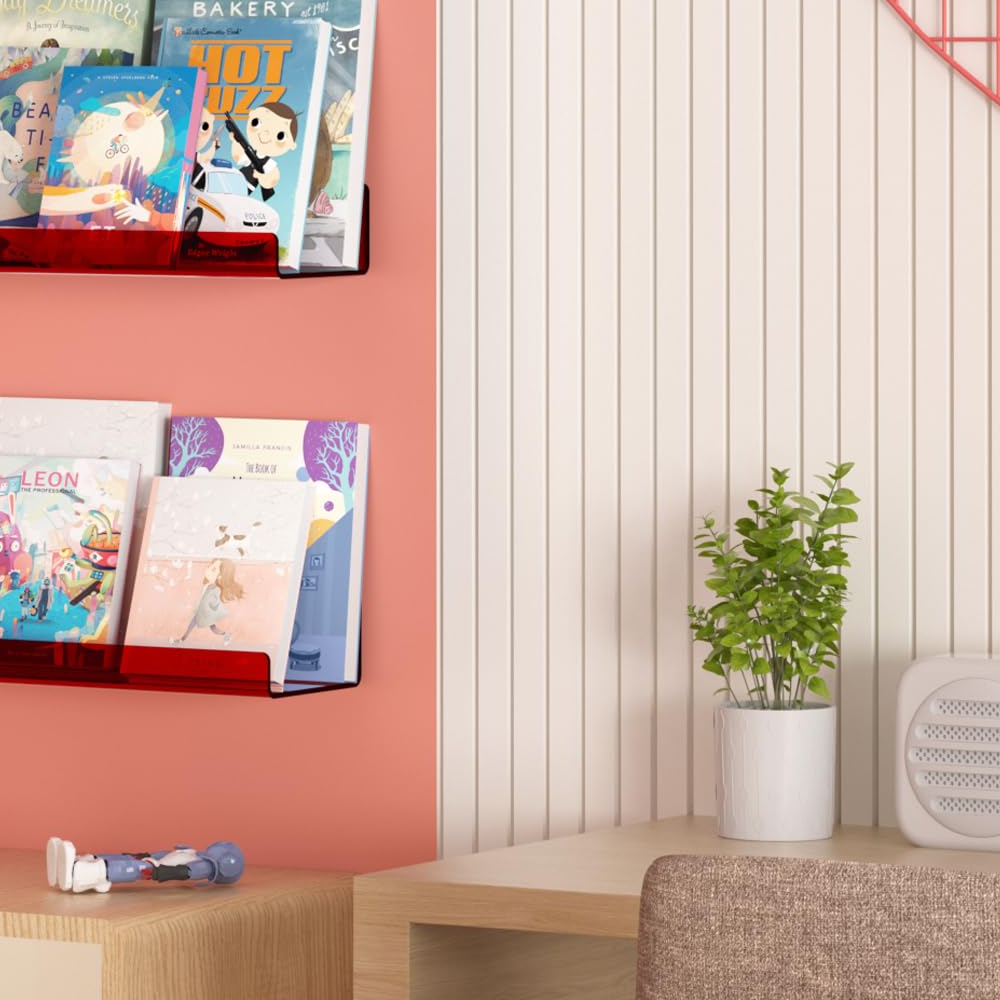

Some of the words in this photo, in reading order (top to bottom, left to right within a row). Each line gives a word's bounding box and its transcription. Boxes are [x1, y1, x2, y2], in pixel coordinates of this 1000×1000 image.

[192, 0, 295, 18] BAKERY
[188, 45, 292, 84] HOT
[206, 85, 288, 115] UZZ
[11, 102, 51, 120] BEA
[244, 212, 266, 220] POLICE
[21, 470, 79, 488] LEON
